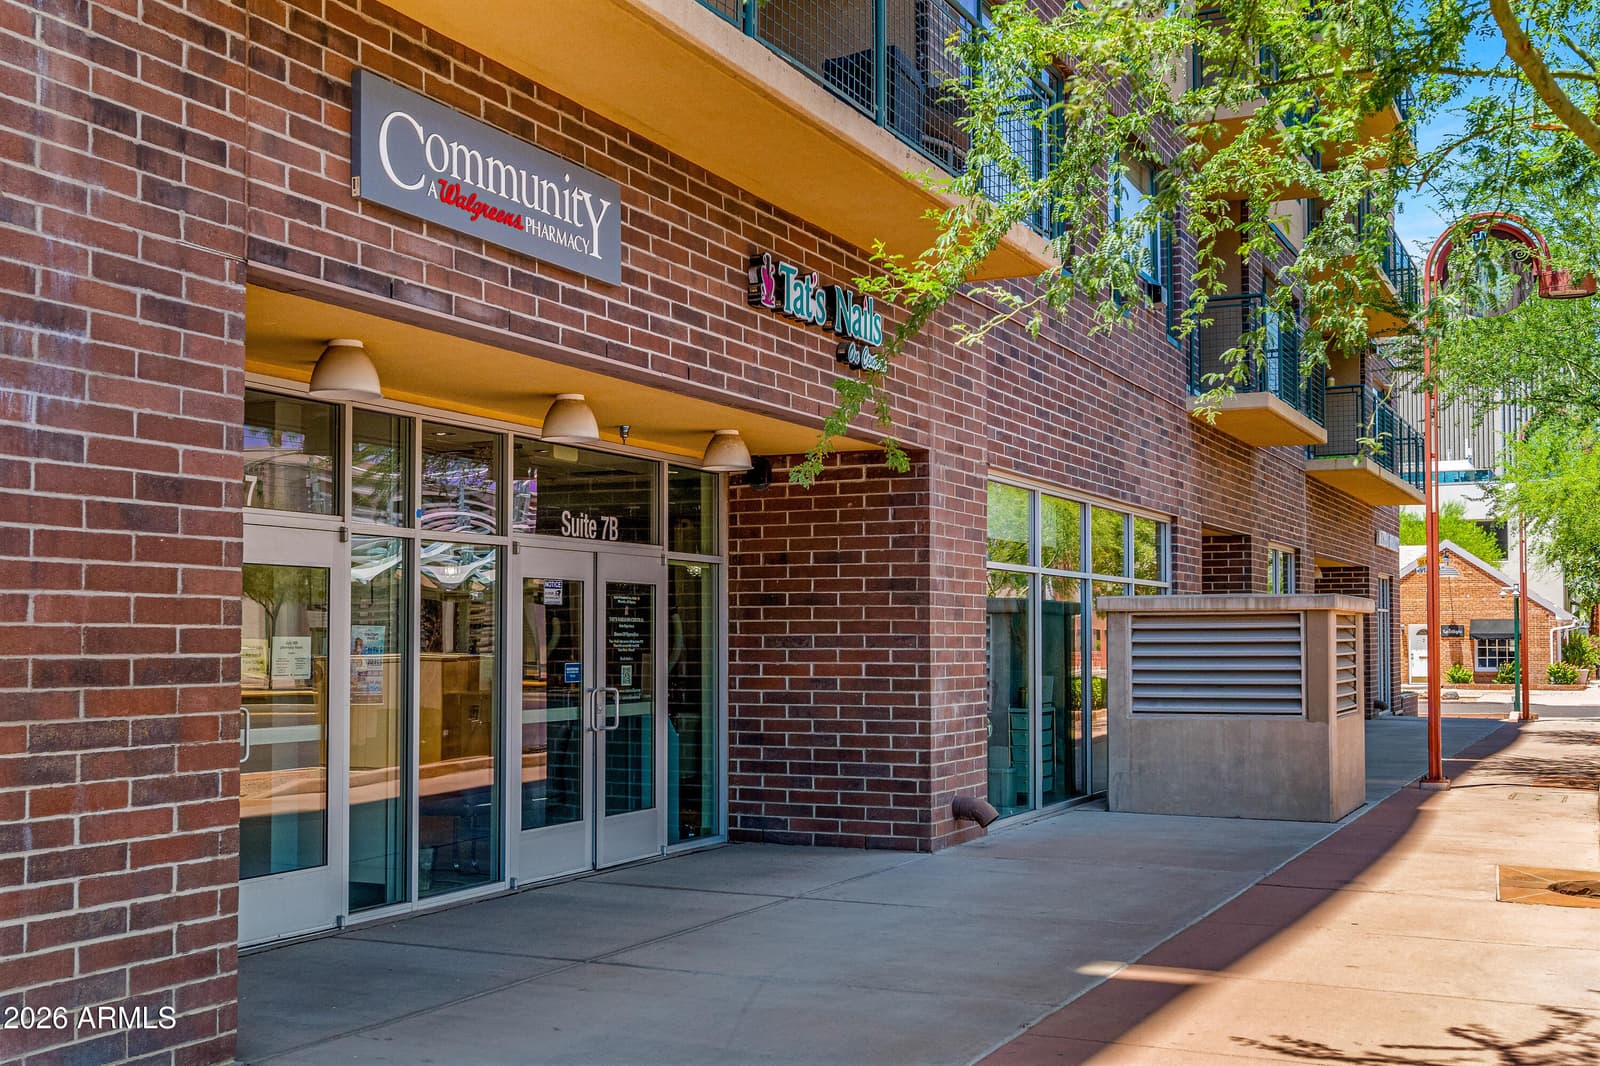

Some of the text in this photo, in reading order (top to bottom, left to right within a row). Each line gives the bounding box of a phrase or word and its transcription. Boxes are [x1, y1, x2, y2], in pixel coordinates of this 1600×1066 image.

[379, 111, 612, 260] Community
[427, 178, 590, 256] A Walgreens PHARMACY
[778, 261, 883, 346] Tat's Nails
[245, 475, 257, 506] 7
[561, 510, 619, 541] Suite 7B
